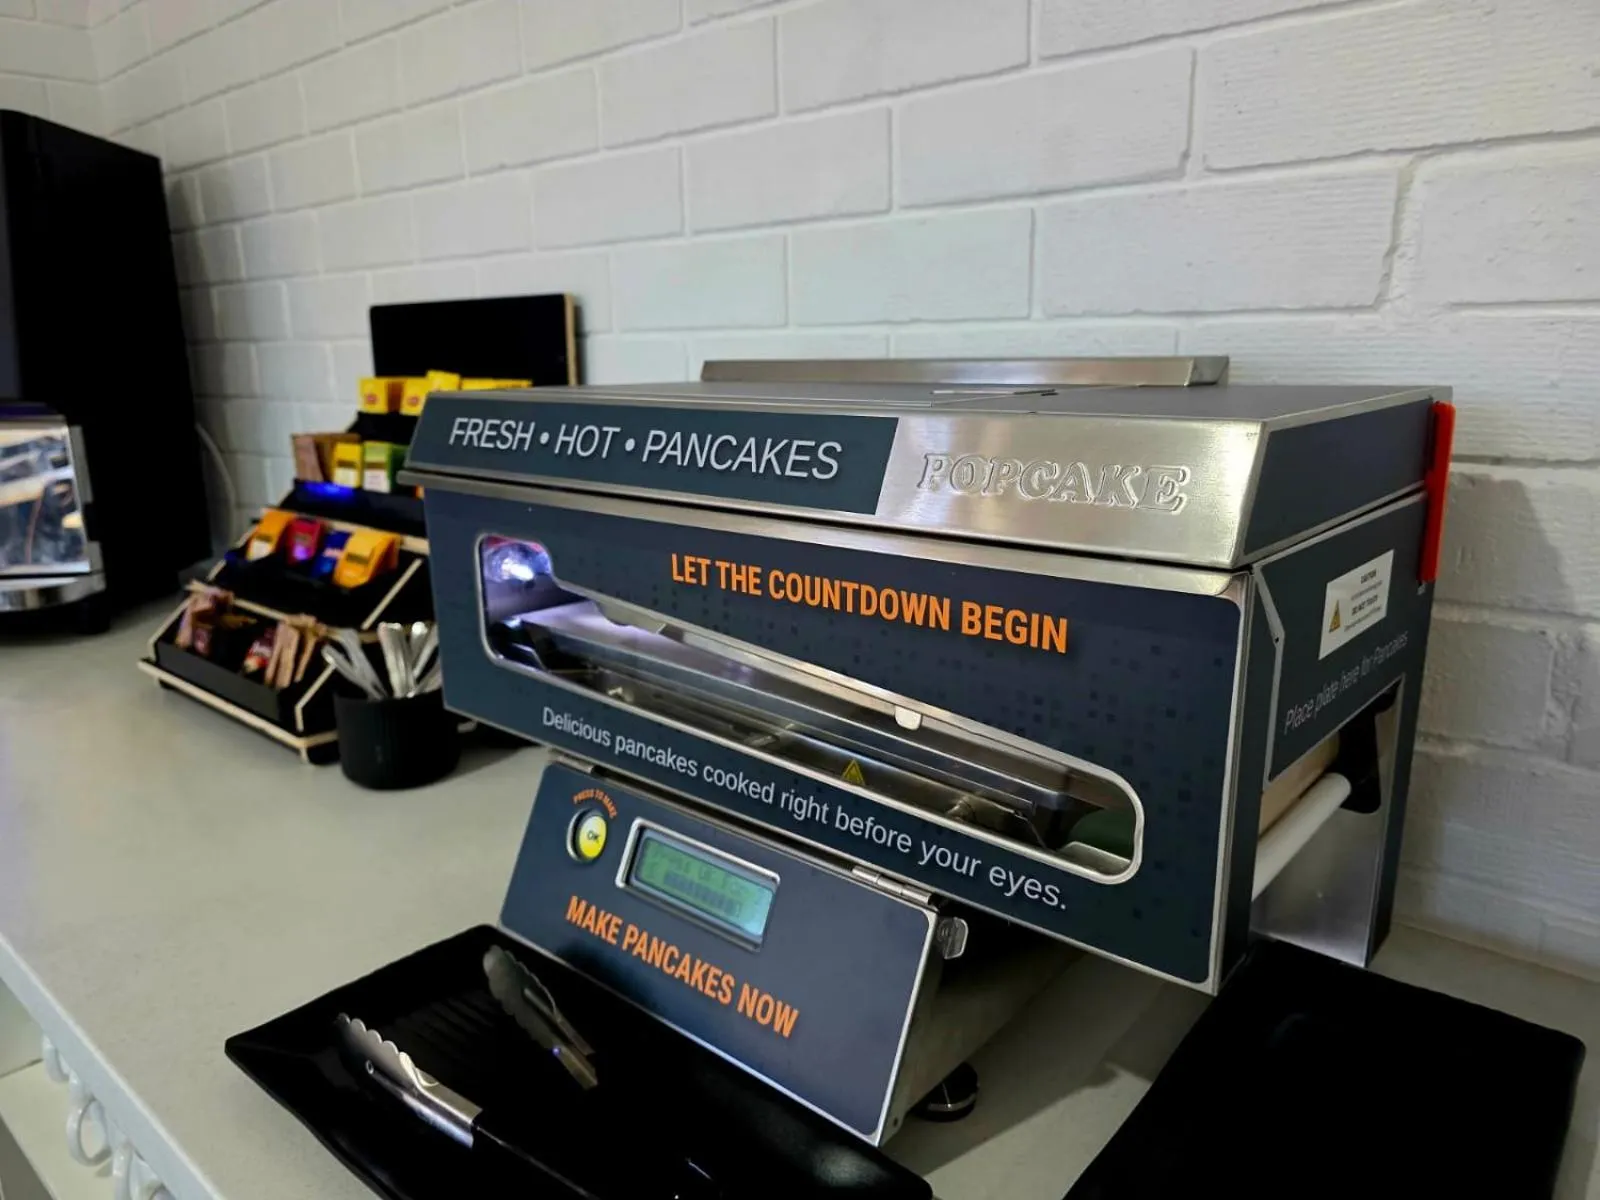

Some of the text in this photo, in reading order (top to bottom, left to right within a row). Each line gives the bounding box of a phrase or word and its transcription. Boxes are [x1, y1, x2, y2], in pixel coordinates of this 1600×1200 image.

[448, 417, 842, 481] FRESH HOT PANCAKES
[917, 452, 1191, 515] POPCAKE
[671, 552, 1068, 654] LET THE COUNTDOWN BEGIN
[1284, 698, 1314, 735] Place
[1314, 680, 1340, 719] plate
[542, 706, 1067, 910] Delicious pancakes cooked right before your eyes.
[565, 895, 800, 1039] MAKE PANCAKES NOW
